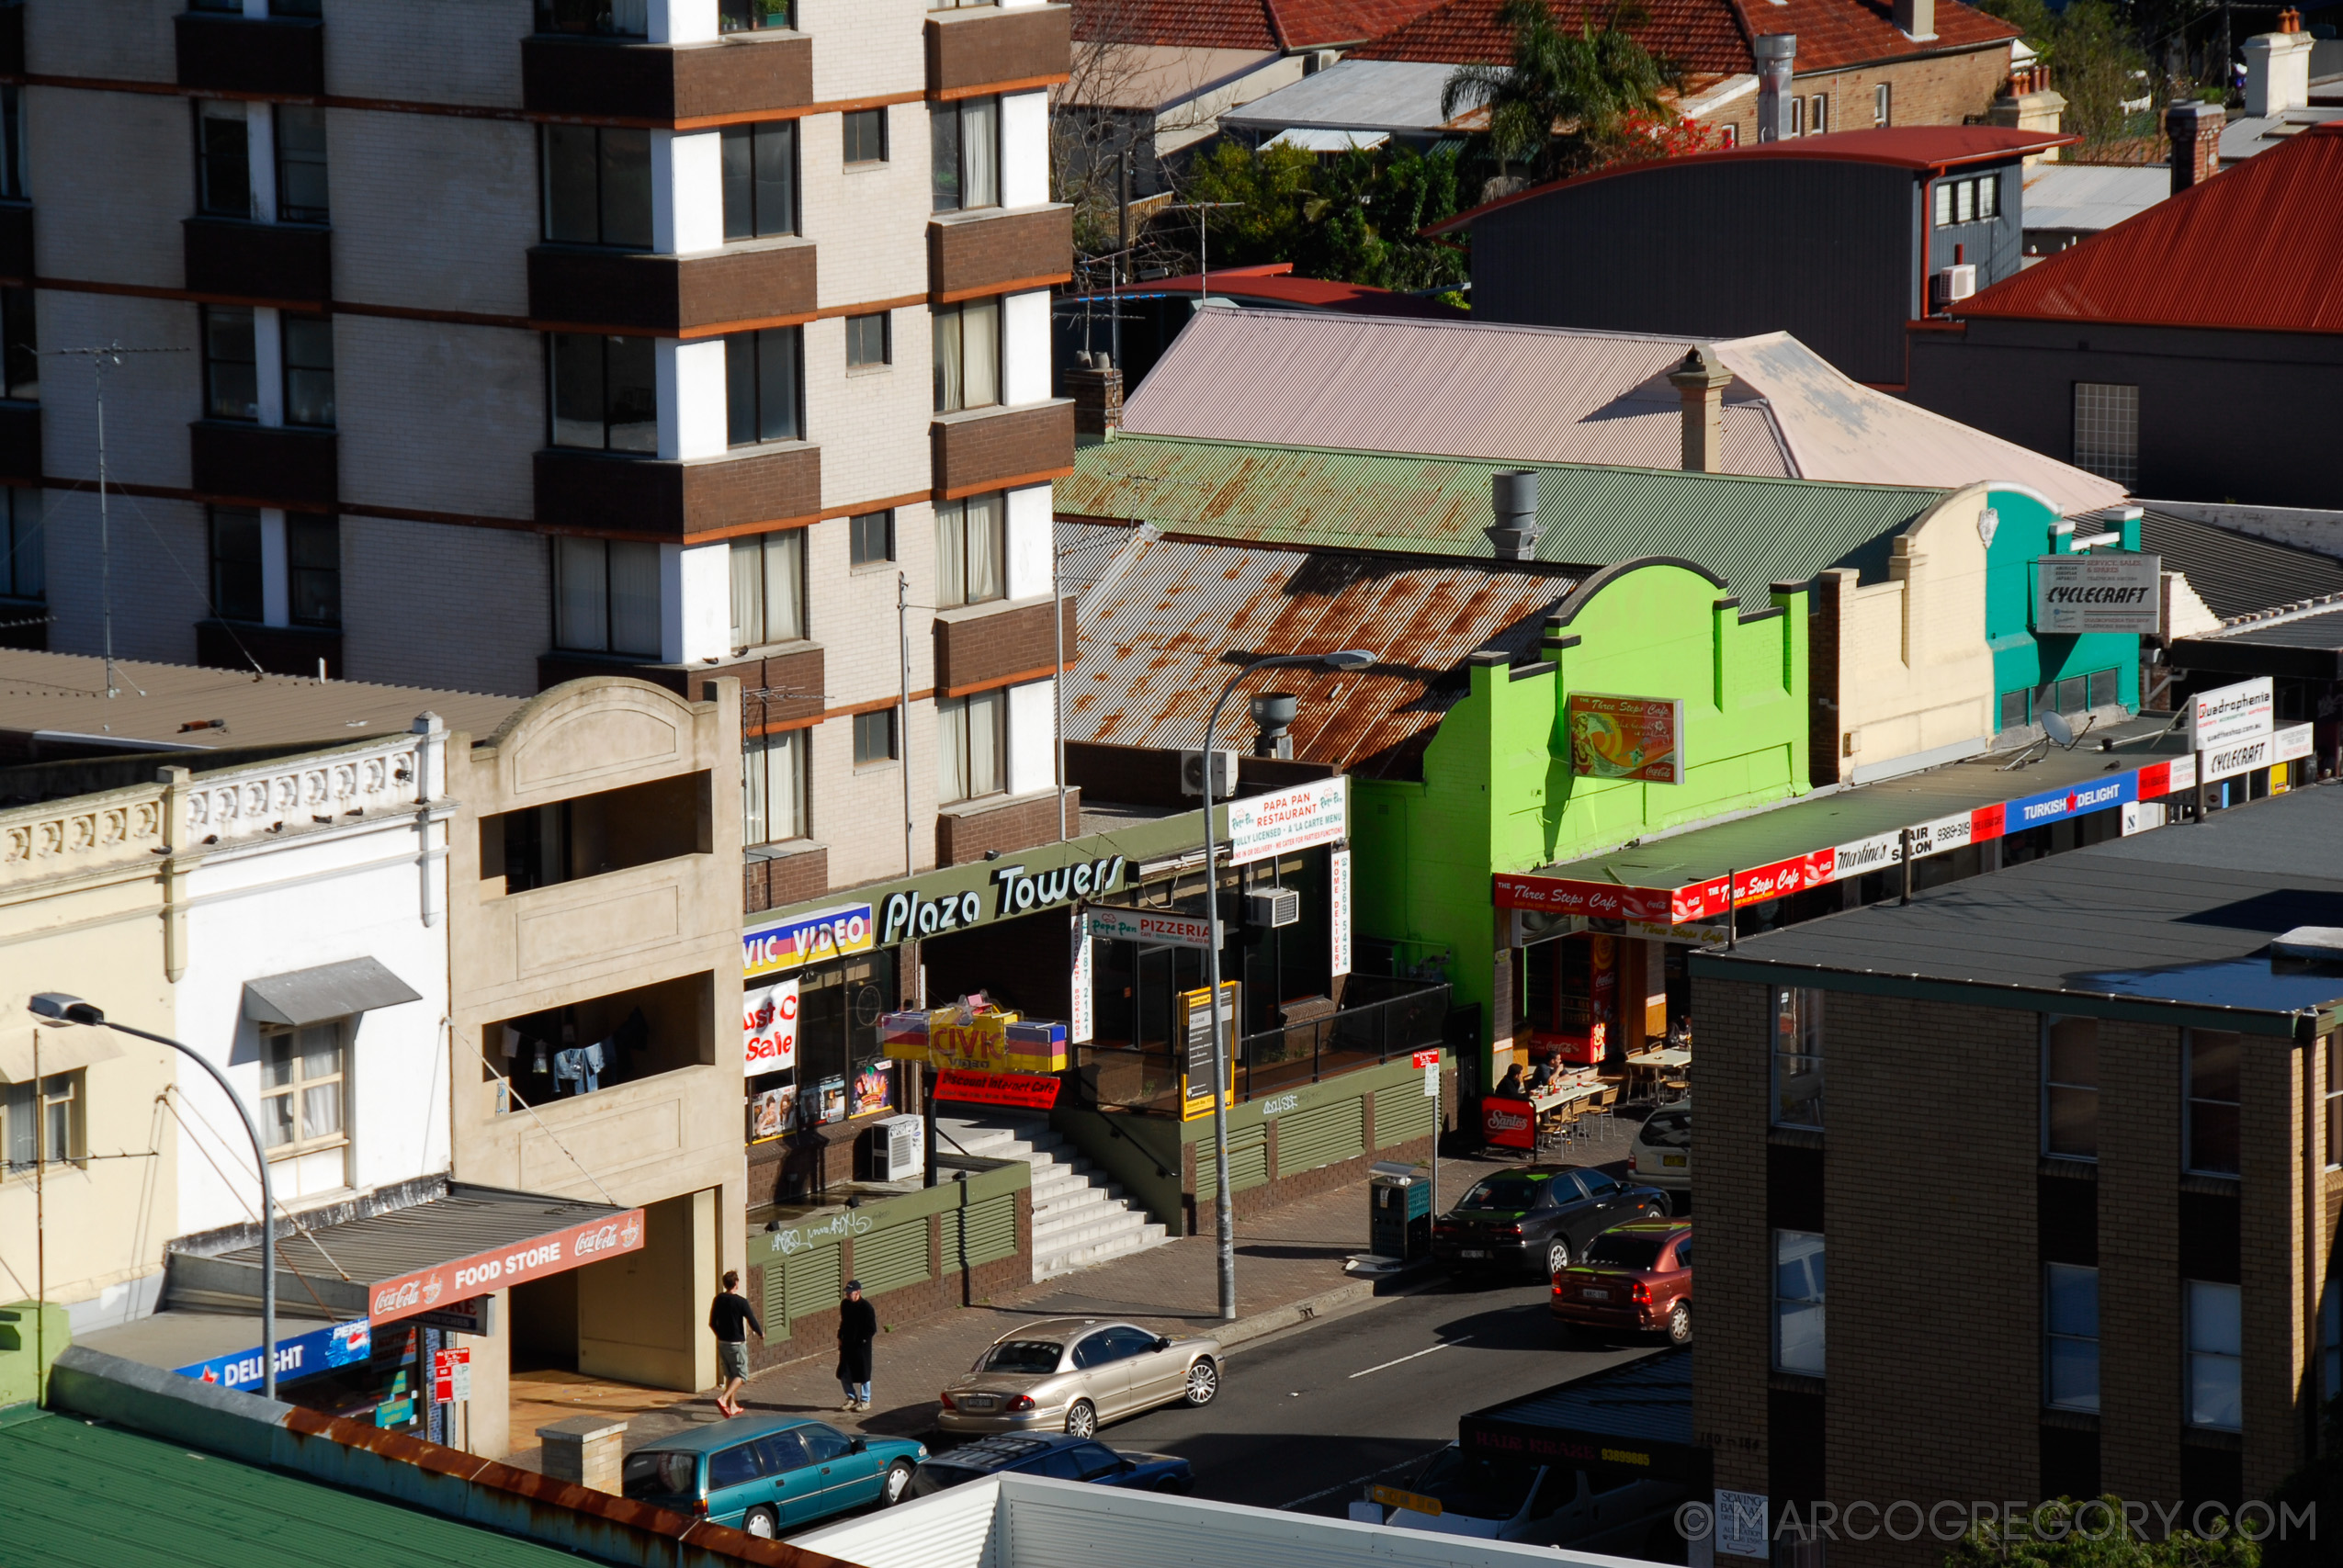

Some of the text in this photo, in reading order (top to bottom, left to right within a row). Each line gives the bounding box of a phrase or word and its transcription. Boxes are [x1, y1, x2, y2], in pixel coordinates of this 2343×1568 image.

[2047, 587, 2150, 603] CYCLECRAFT
[1592, 699, 1615, 710] Three
[1619, 702, 1643, 714] Steps
[1647, 704, 1669, 717] Cafe
[2199, 692, 2270, 719] Quadrophenia
[2211, 742, 2266, 773] CYCLECRAFT
[1257, 804, 1317, 827] RESTAURANT
[1264, 792, 1310, 812] PAPA PAN
[2024, 784, 2120, 820] TURKISH DELIGHT
[1233, 835, 1251, 847] FULLY
[1253, 828, 1281, 843] LICENSED
[1304, 817, 1324, 830] CARTE
[1325, 812, 1342, 824] MENU
[1254, 844, 1273, 855] DELIVERY
[1283, 839, 1294, 847] CATER
[1838, 841, 1887, 870] Martine's
[1891, 840, 1932, 861] SLON
[1498, 881, 1618, 909] THE Three Steps Cafe
[1708, 868, 1800, 903] THE Tree Steps Cafe
[881, 855, 1124, 944] Plaza Towers
[793, 915, 864, 957] VIDEO
[1092, 919, 1210, 938] Papa Pan PIZZERIA
[1642, 922, 1668, 936] Three
[1671, 926, 1698, 939] Steps
[1701, 929, 1725, 943] Cafe
[744, 1001, 776, 1031] ust
[746, 1031, 793, 1061] Sale
[934, 1027, 1002, 1060] CIVIC
[1546, 1041, 1572, 1054] Coca-Cola
[948, 1058, 990, 1070] VIDEO
[943, 1072, 1056, 1094] Discount Internet Cafe
[1488, 1110, 1528, 1130] Santos
[574, 1224, 619, 1258] Coca-Cola
[455, 1242, 561, 1289] FOOD STORE
[374, 1280, 421, 1315] Coca-Cola
[333, 1320, 368, 1340] PEPSI
[462, 1365, 468, 1375] P
[1475, 1430, 1523, 1451] HAIR
[1528, 1438, 1596, 1461] KRAZE
[1721, 1492, 1761, 1506] SEWING
